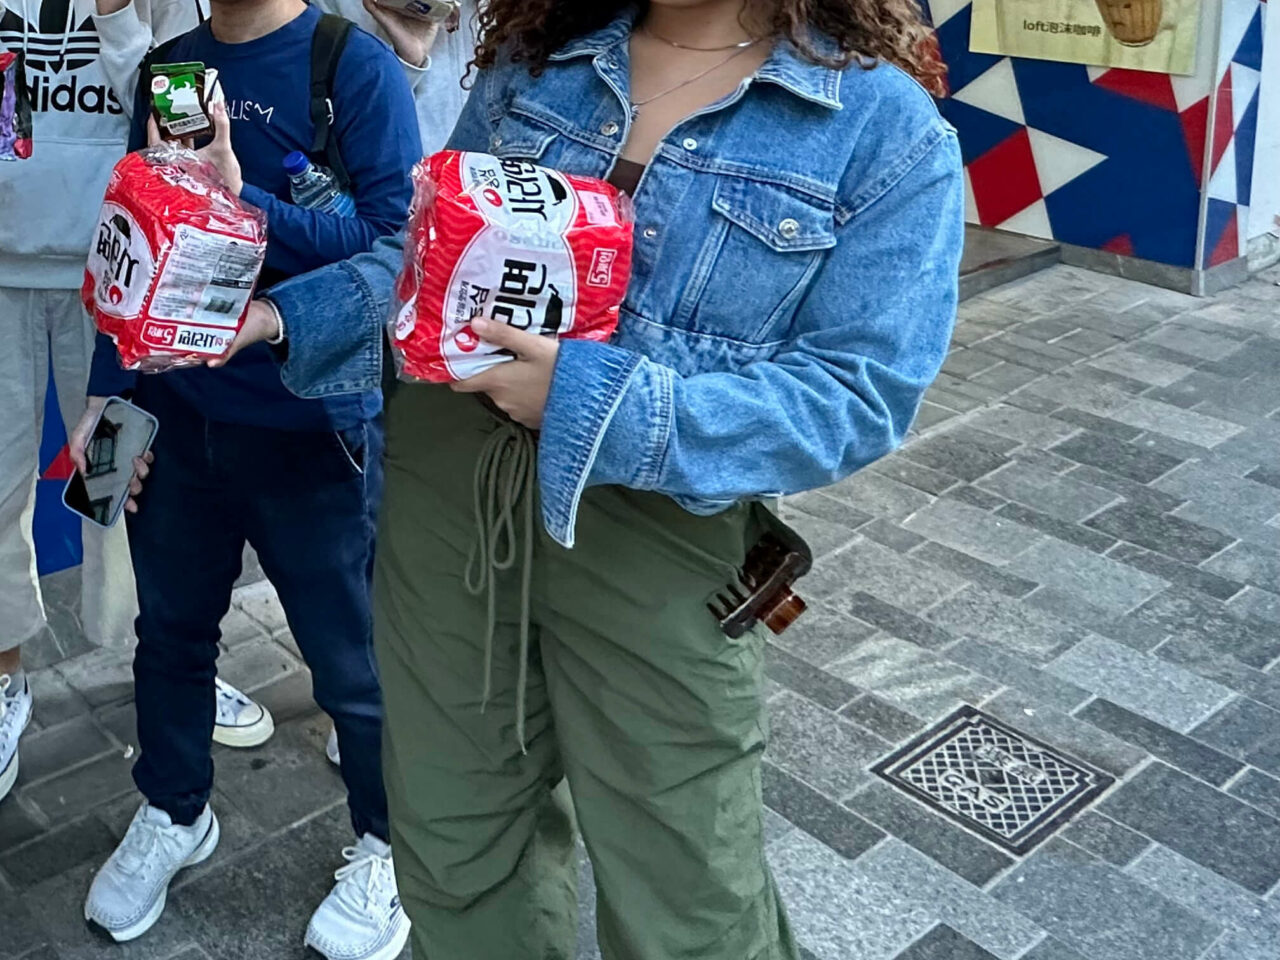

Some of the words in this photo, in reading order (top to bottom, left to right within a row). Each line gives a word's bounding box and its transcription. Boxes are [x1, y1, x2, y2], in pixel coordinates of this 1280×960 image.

[491, 258, 548, 331] 리면
[177, 329, 216, 348] 사리면
[944, 773, 1005, 809] GAS
